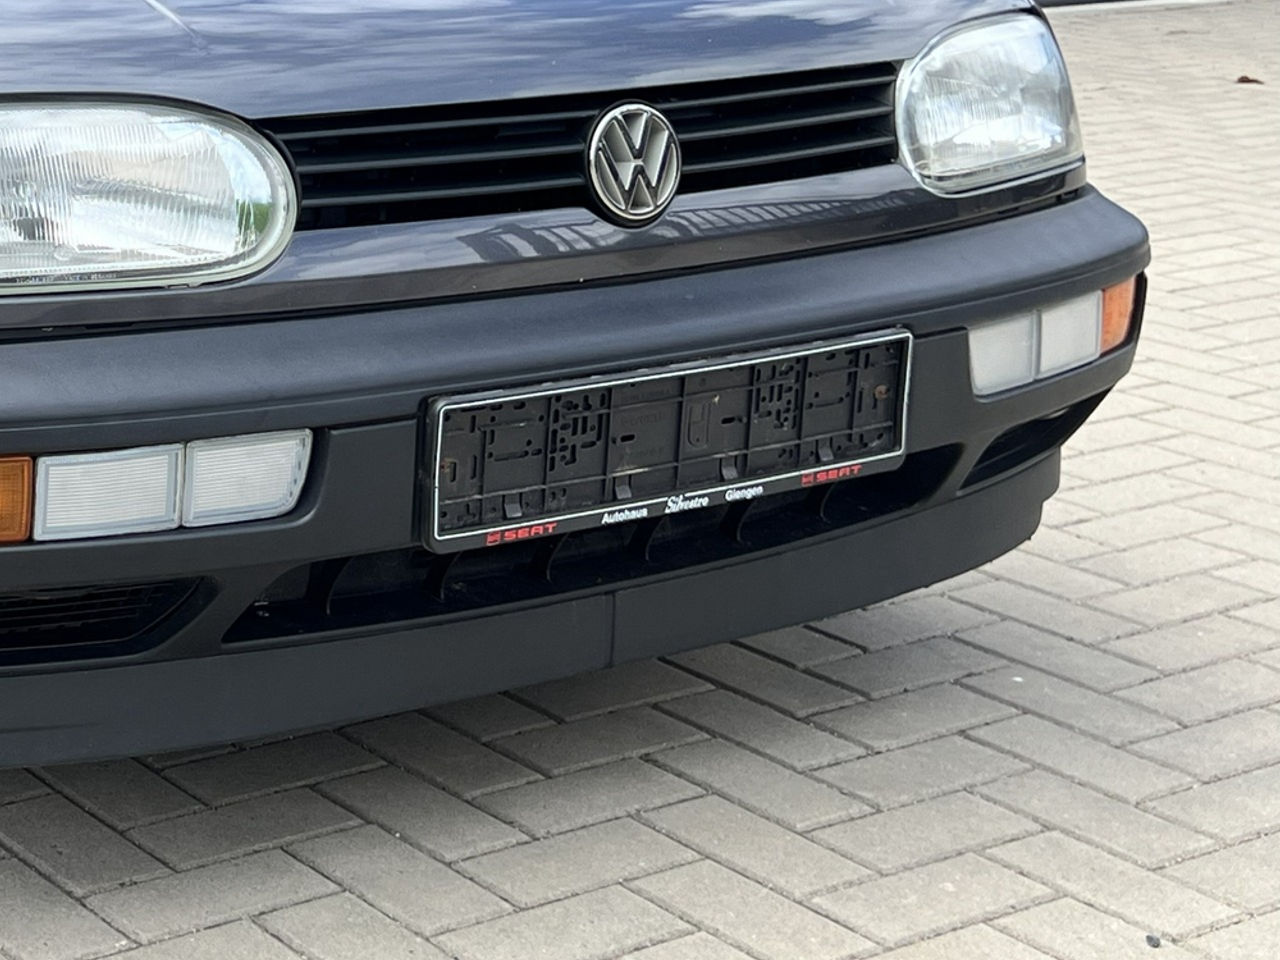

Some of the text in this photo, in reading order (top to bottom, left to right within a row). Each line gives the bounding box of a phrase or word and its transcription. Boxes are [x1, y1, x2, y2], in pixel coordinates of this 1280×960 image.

[591, 105, 680, 219] VW
[504, 522, 557, 540] SEAT
[601, 507, 648, 524] Autohaus
[816, 464, 862, 482] SEAT
